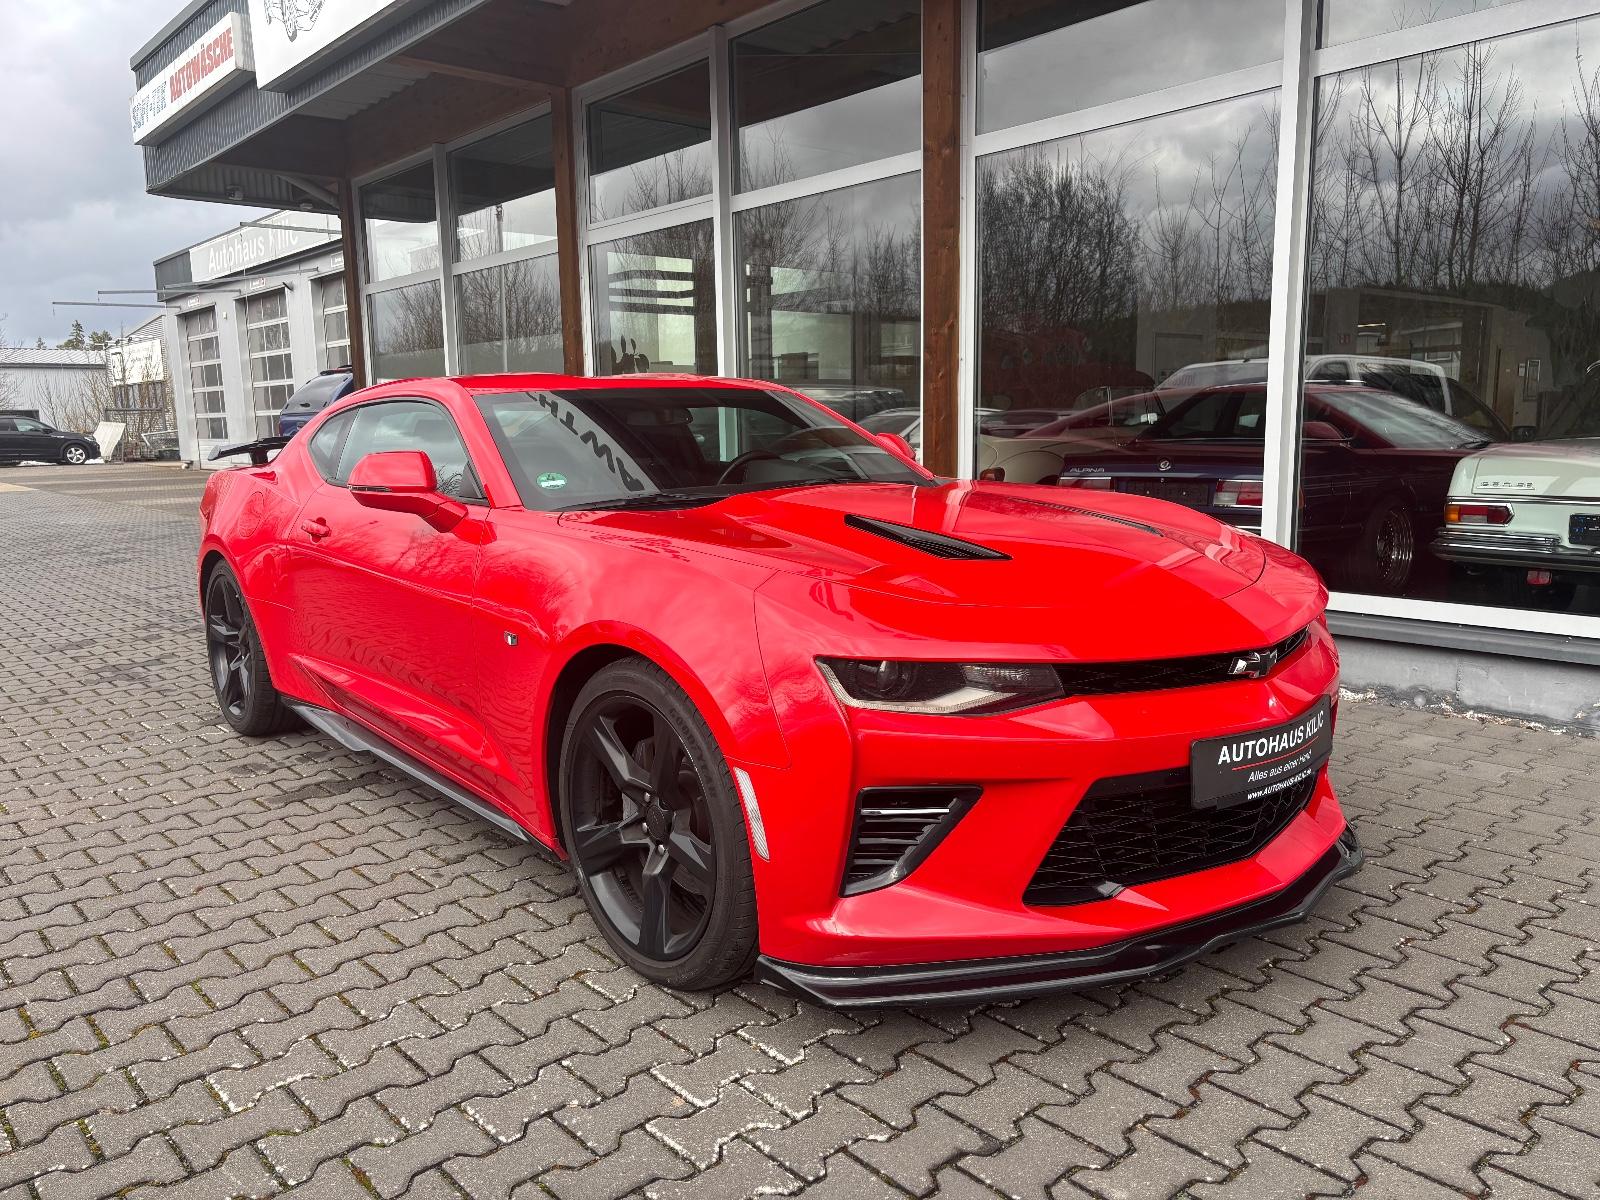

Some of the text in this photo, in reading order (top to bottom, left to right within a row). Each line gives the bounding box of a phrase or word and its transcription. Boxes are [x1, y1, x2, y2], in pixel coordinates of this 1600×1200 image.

[169, 27, 234, 103] AUTOWÄSCHE
[208, 234, 265, 273] Autohaus
[1217, 710, 1325, 765] AUTOHAUS KILIC
[1247, 749, 1313, 783] Alles aus einer Hand
